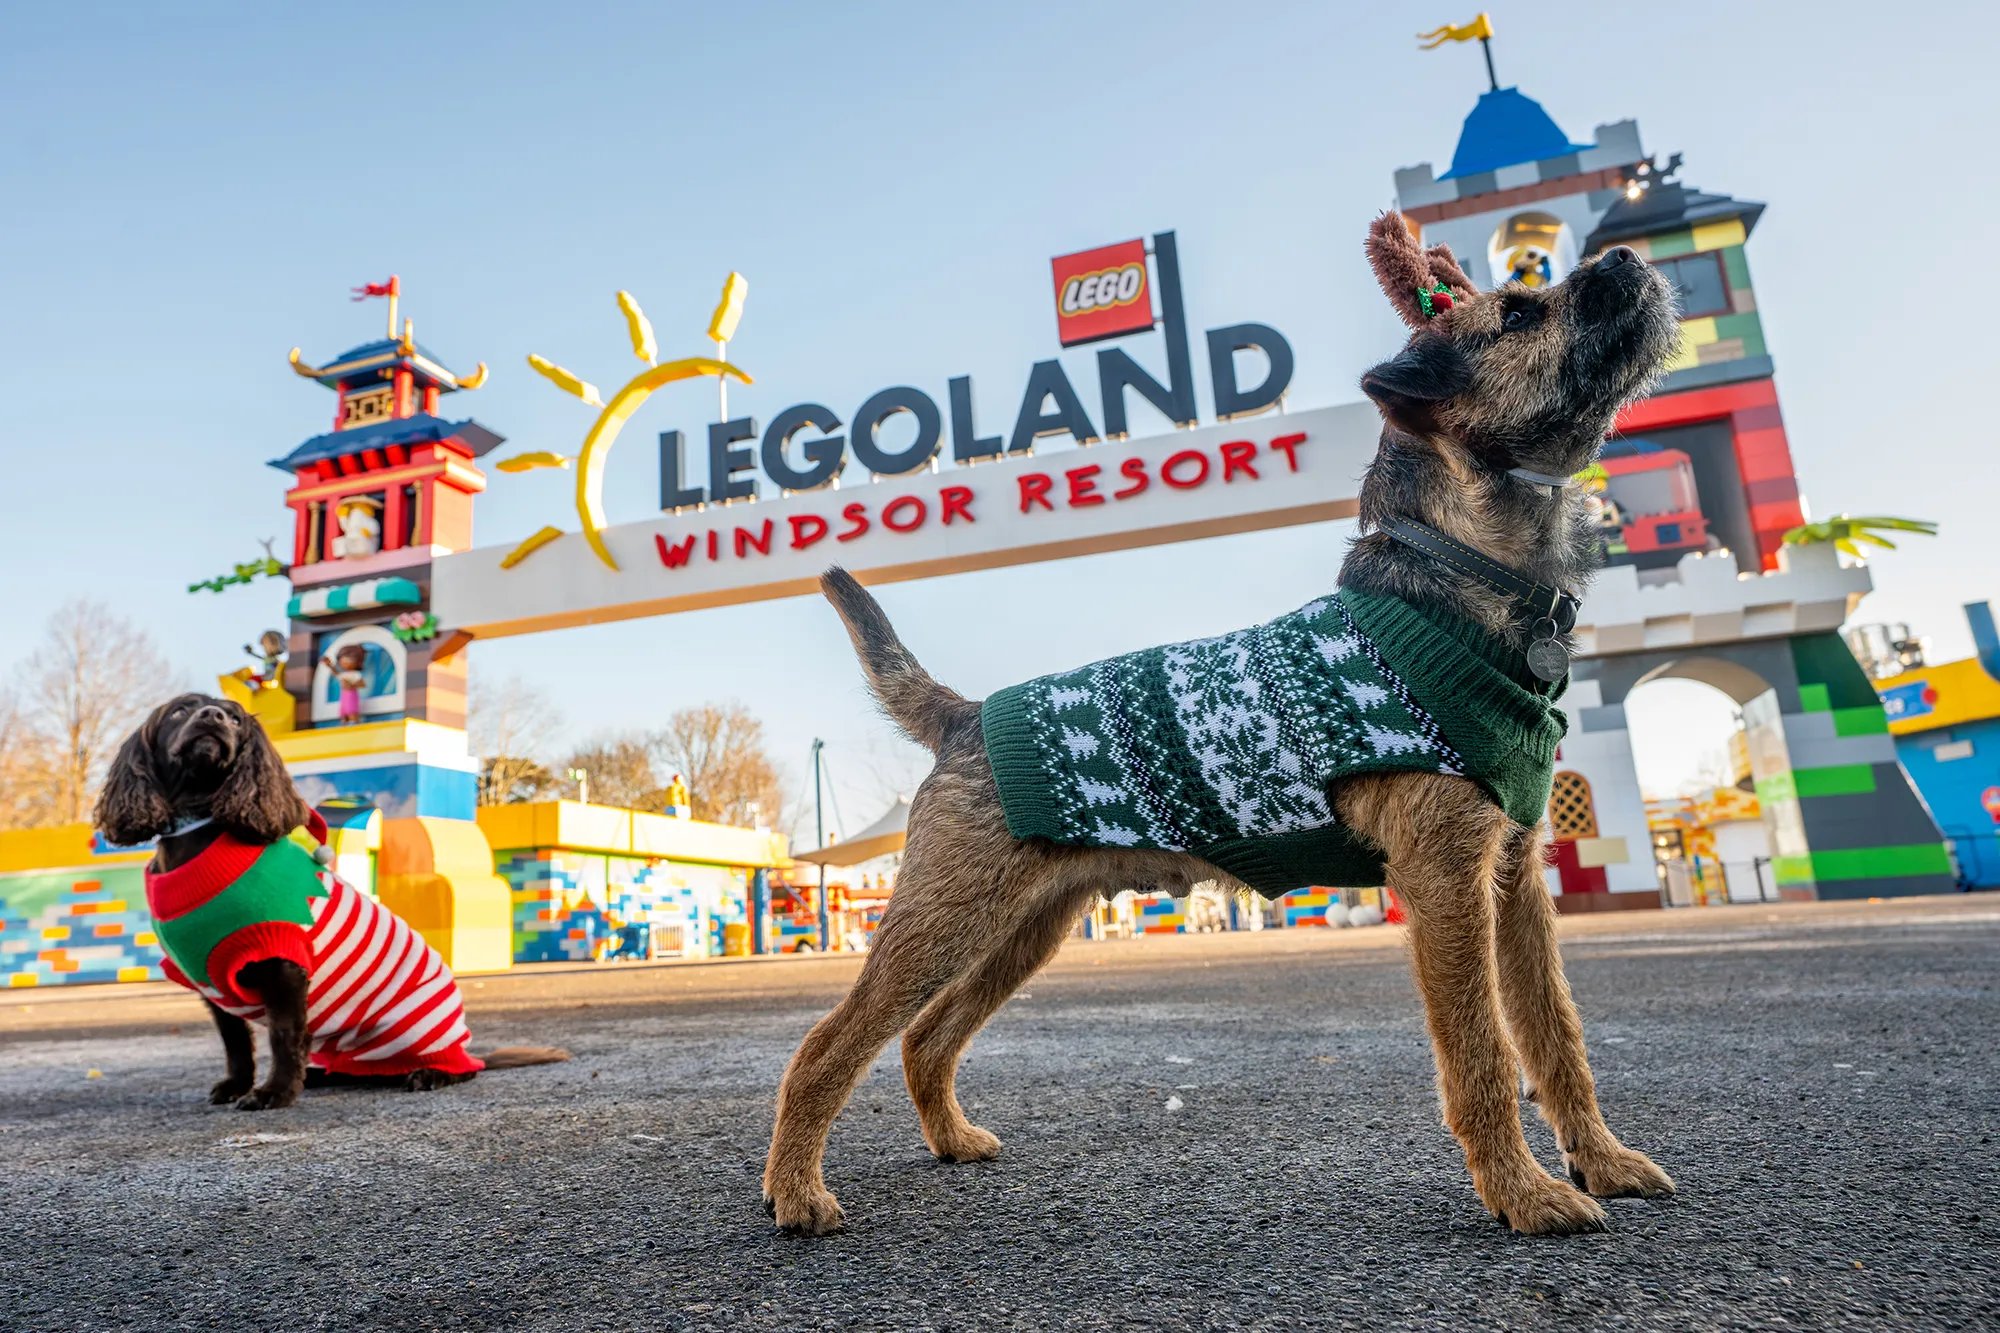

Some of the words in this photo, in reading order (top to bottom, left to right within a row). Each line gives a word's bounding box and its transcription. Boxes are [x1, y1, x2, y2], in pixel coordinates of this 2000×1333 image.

[1062, 266, 1142, 313] LEGO
[659, 229, 1294, 512] LEGOLAND
[655, 486, 976, 569] WINDSOR
[1017, 432, 1307, 514] RESORT
